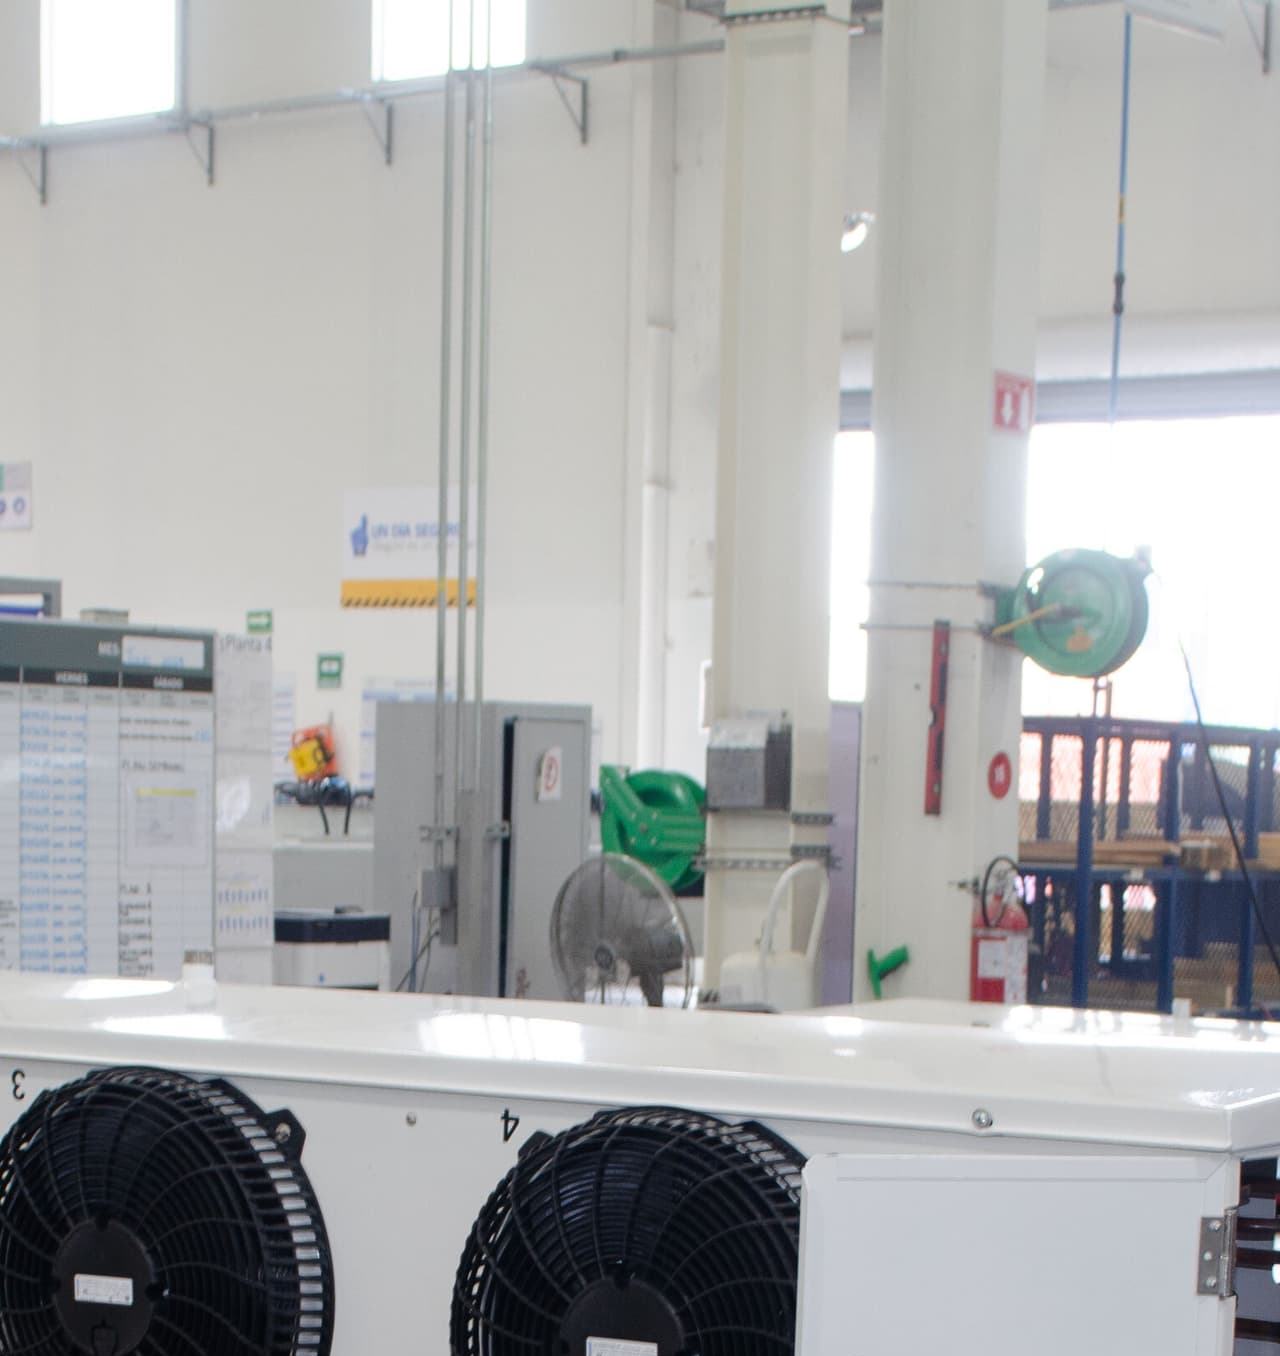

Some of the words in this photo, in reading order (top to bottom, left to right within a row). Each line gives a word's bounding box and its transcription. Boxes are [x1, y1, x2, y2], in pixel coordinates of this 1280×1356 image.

[55, 671, 89, 686] VIERNES
[11, 1070, 26, 1100] 3
[500, 1108, 520, 1142] 4
